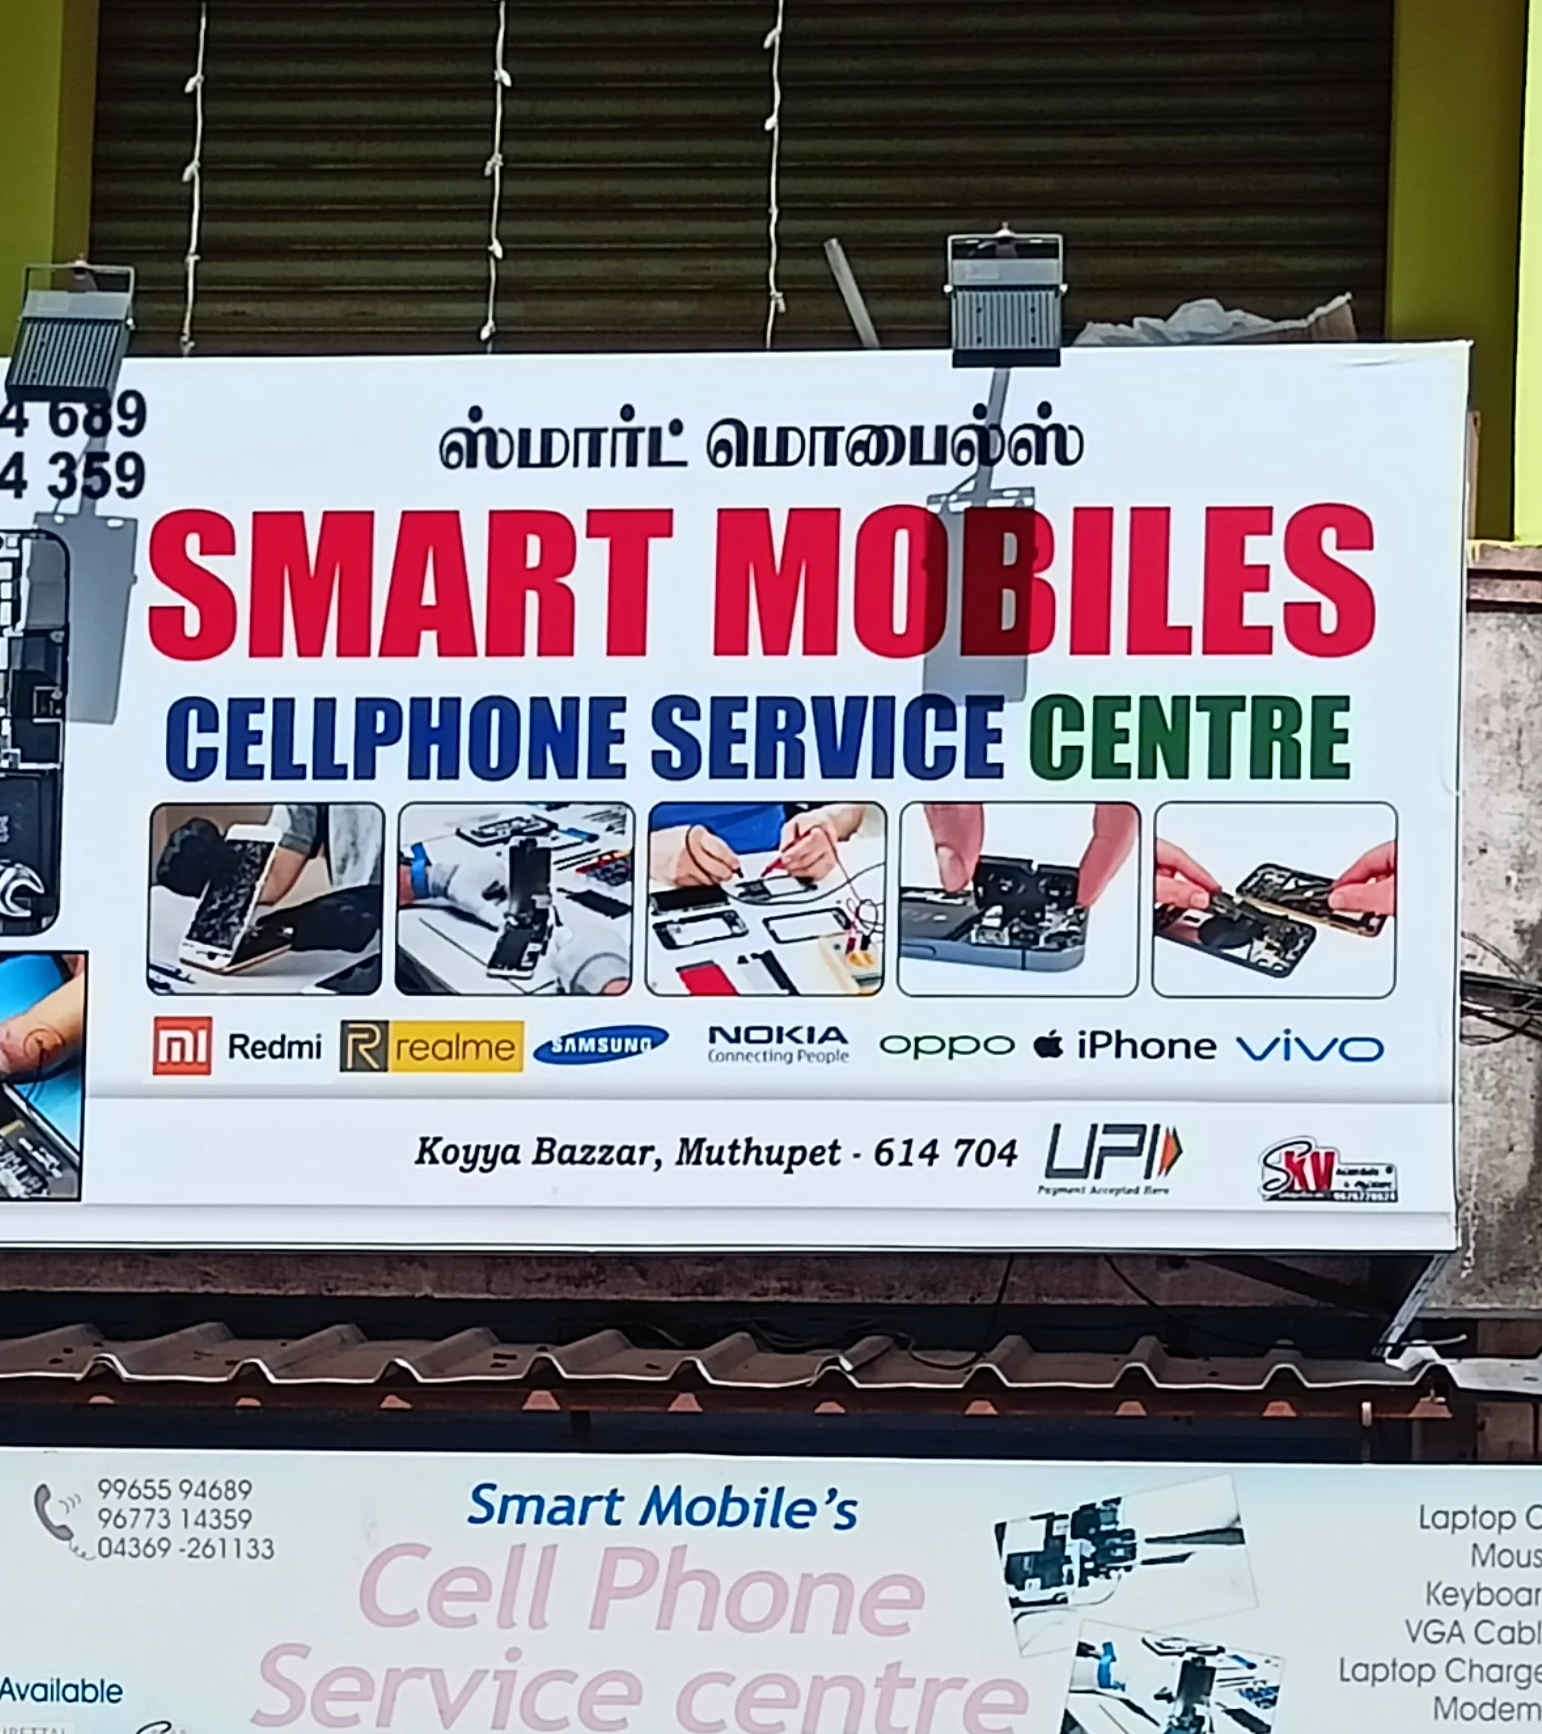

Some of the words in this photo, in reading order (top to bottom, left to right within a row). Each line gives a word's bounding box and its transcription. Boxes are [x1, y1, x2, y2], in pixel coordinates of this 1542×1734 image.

[47, 388, 147, 438] 689
[439, 404, 687, 469] ஸ்மார்ட்
[47, 451, 147, 499] 359
[148, 508, 674, 661] SMART
[713, 502, 1376, 659] MOBILES
[166, 695, 627, 782] CELLPHONE
[650, 694, 1004, 780] SERVICE
[1029, 694, 1351, 780] CENTRE
[229, 1033, 321, 1060] Redmi
[396, 1034, 516, 1064] realme
[551, 1035, 653, 1056] SAMSUNG
[709, 1025, 848, 1045] NOKIA
[879, 1033, 1016, 1060] oppo
[1077, 1030, 1218, 1061] iPhone
[1235, 1028, 1385, 1062] vivo
[708, 1048, 792, 1065] Connecting
[796, 1048, 849, 1065] People
[414, 1136, 521, 1173] Koyya
[532, 1137, 663, 1172] Bazzar,
[675, 1136, 841, 1174] Muthupet
[873, 1138, 940, 1168] 614
[953, 1138, 1019, 1168] 704
[1045, 1123, 1161, 1180] UPI
[98, 1478, 171, 1501] 99655
[179, 1479, 252, 1502] 94689
[467, 1482, 624, 1527] Smart
[98, 1508, 171, 1530] 96773
[182, 1509, 252, 1531] 14359
[1419, 1504, 1517, 1534] Laptop
[98, 1537, 171, 1560] 04369
[358, 1541, 562, 1632] Cell
[589, 1545, 926, 1637] Phone
[1406, 1619, 1465, 1645] VGA
[249, 1643, 643, 1734] Service
[1339, 1657, 1436, 1687] Laptop
